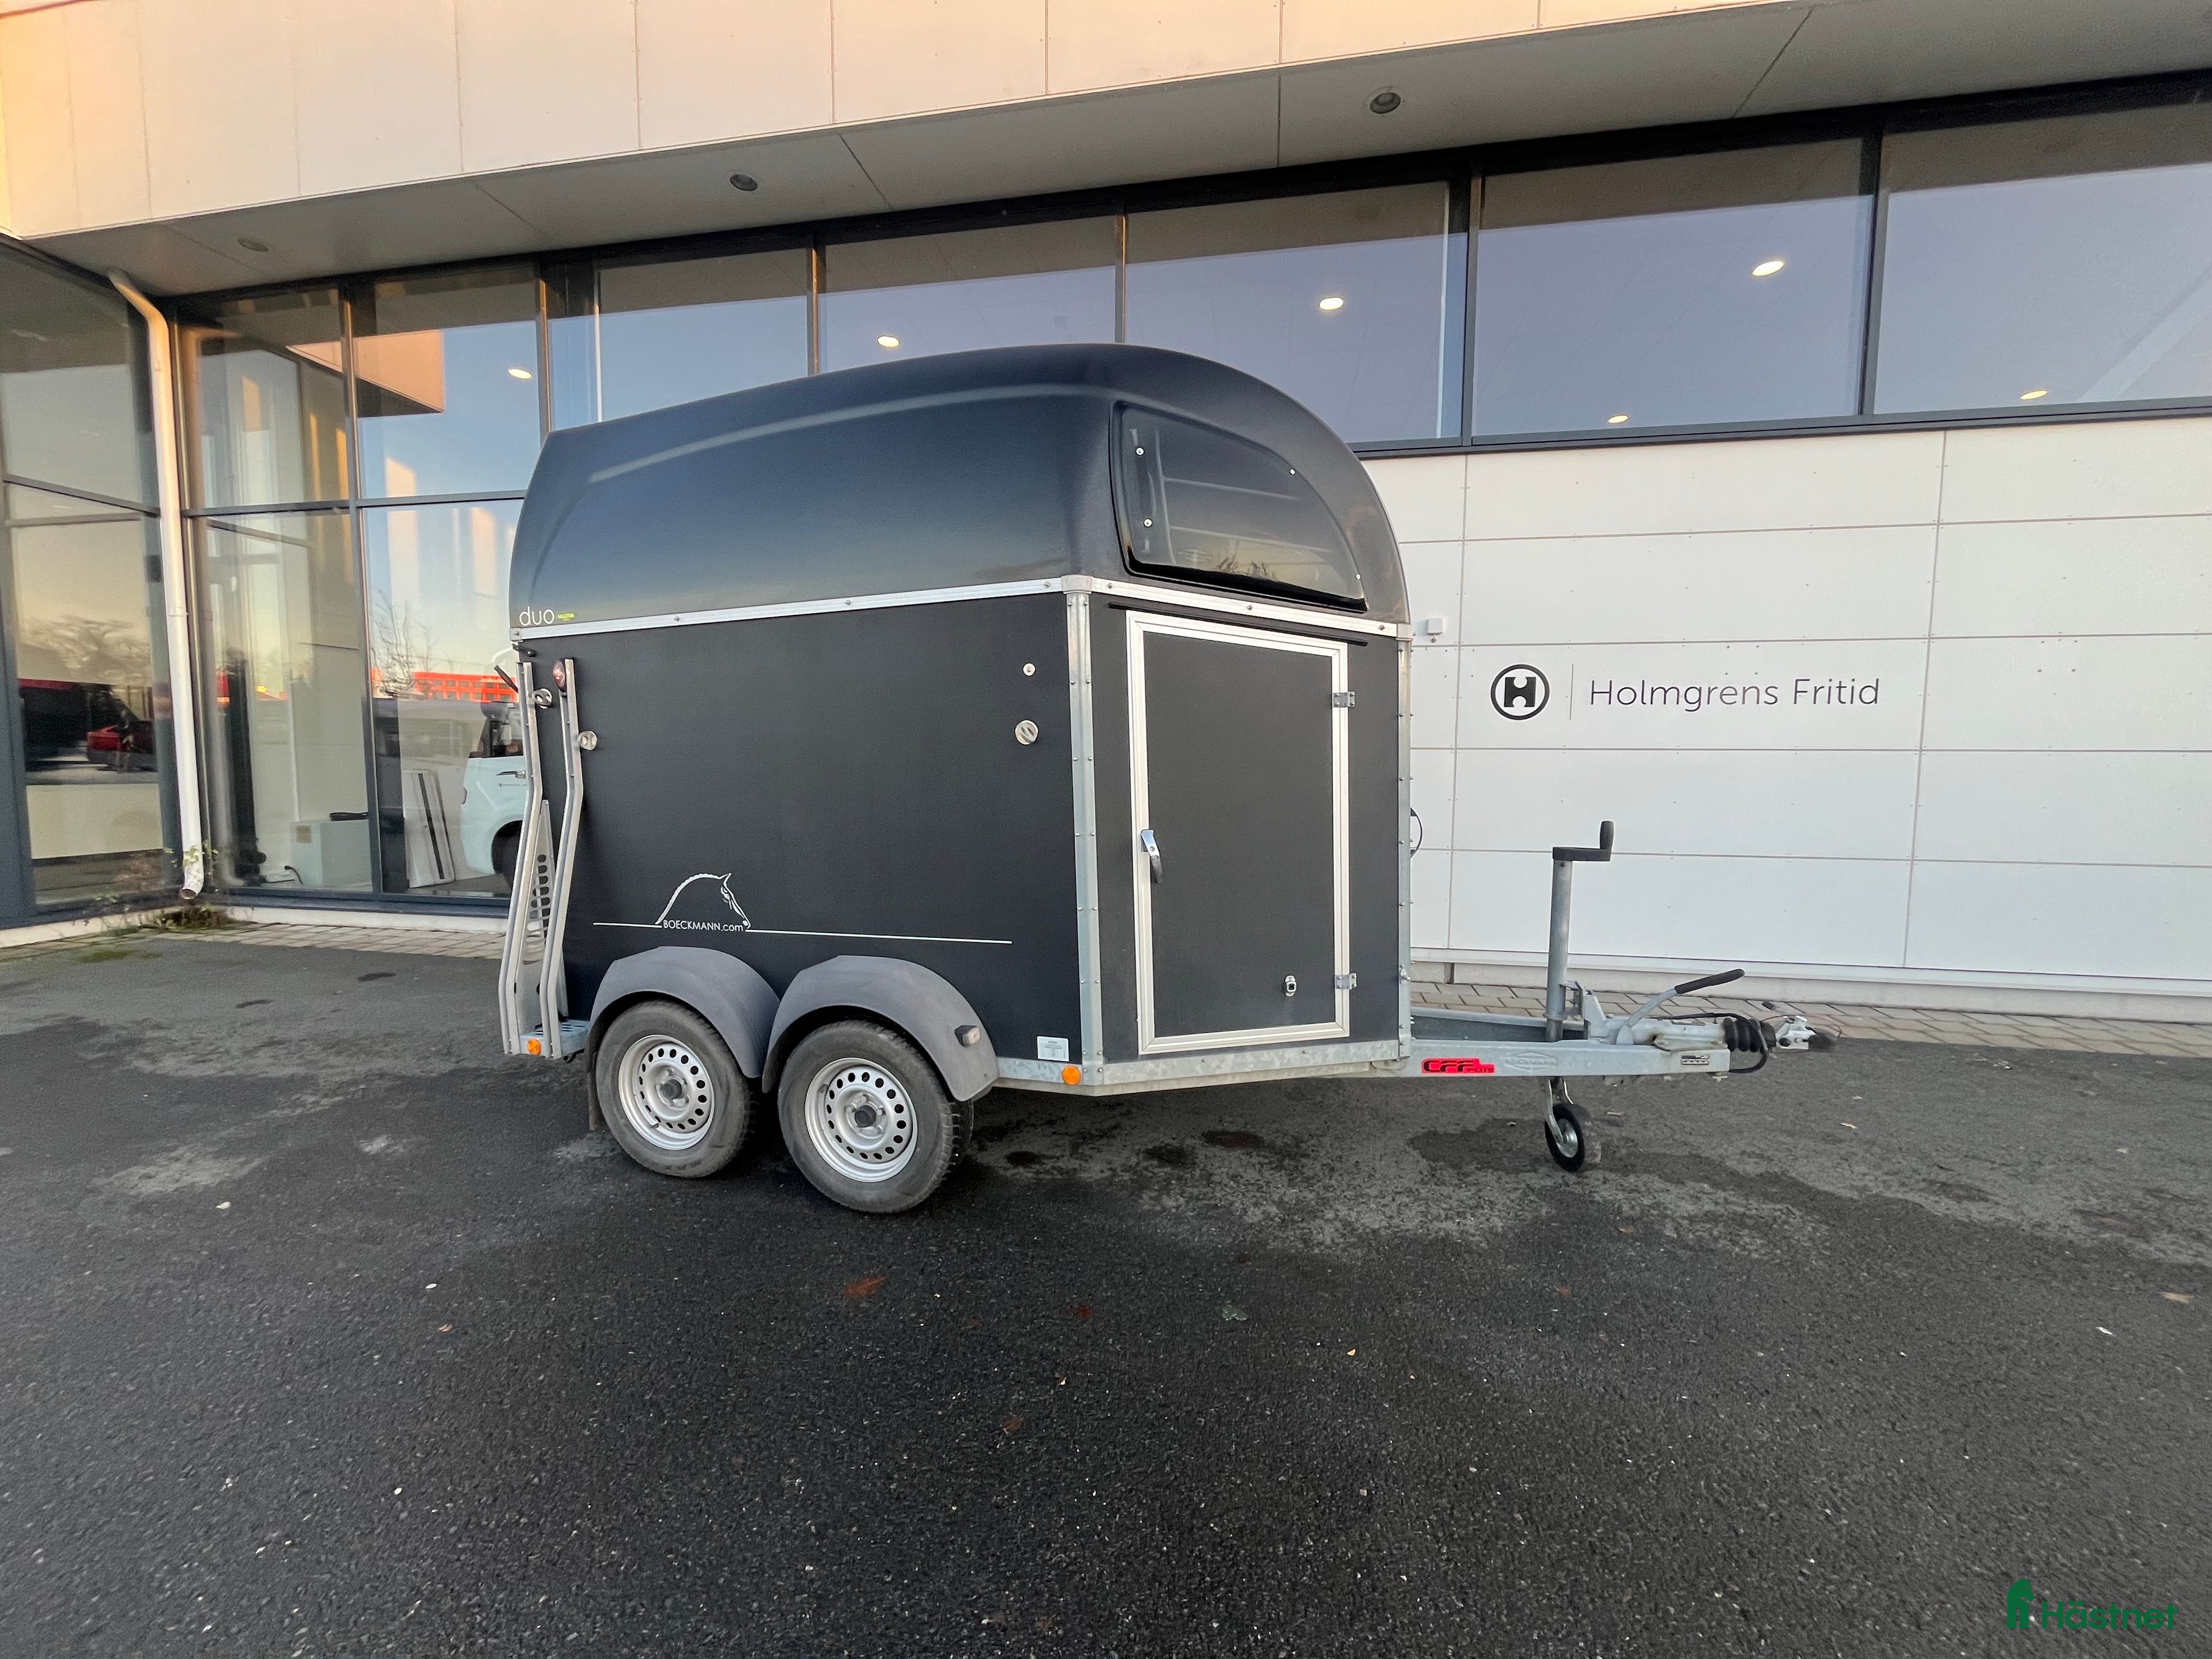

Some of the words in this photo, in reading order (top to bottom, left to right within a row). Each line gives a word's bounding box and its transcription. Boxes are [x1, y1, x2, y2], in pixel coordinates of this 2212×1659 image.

[518, 606, 555, 626] duo
[1590, 679, 1779, 712] Holmgrens
[1793, 678, 1880, 705] Fritid
[663, 919, 743, 932] BOECKMANN.com
